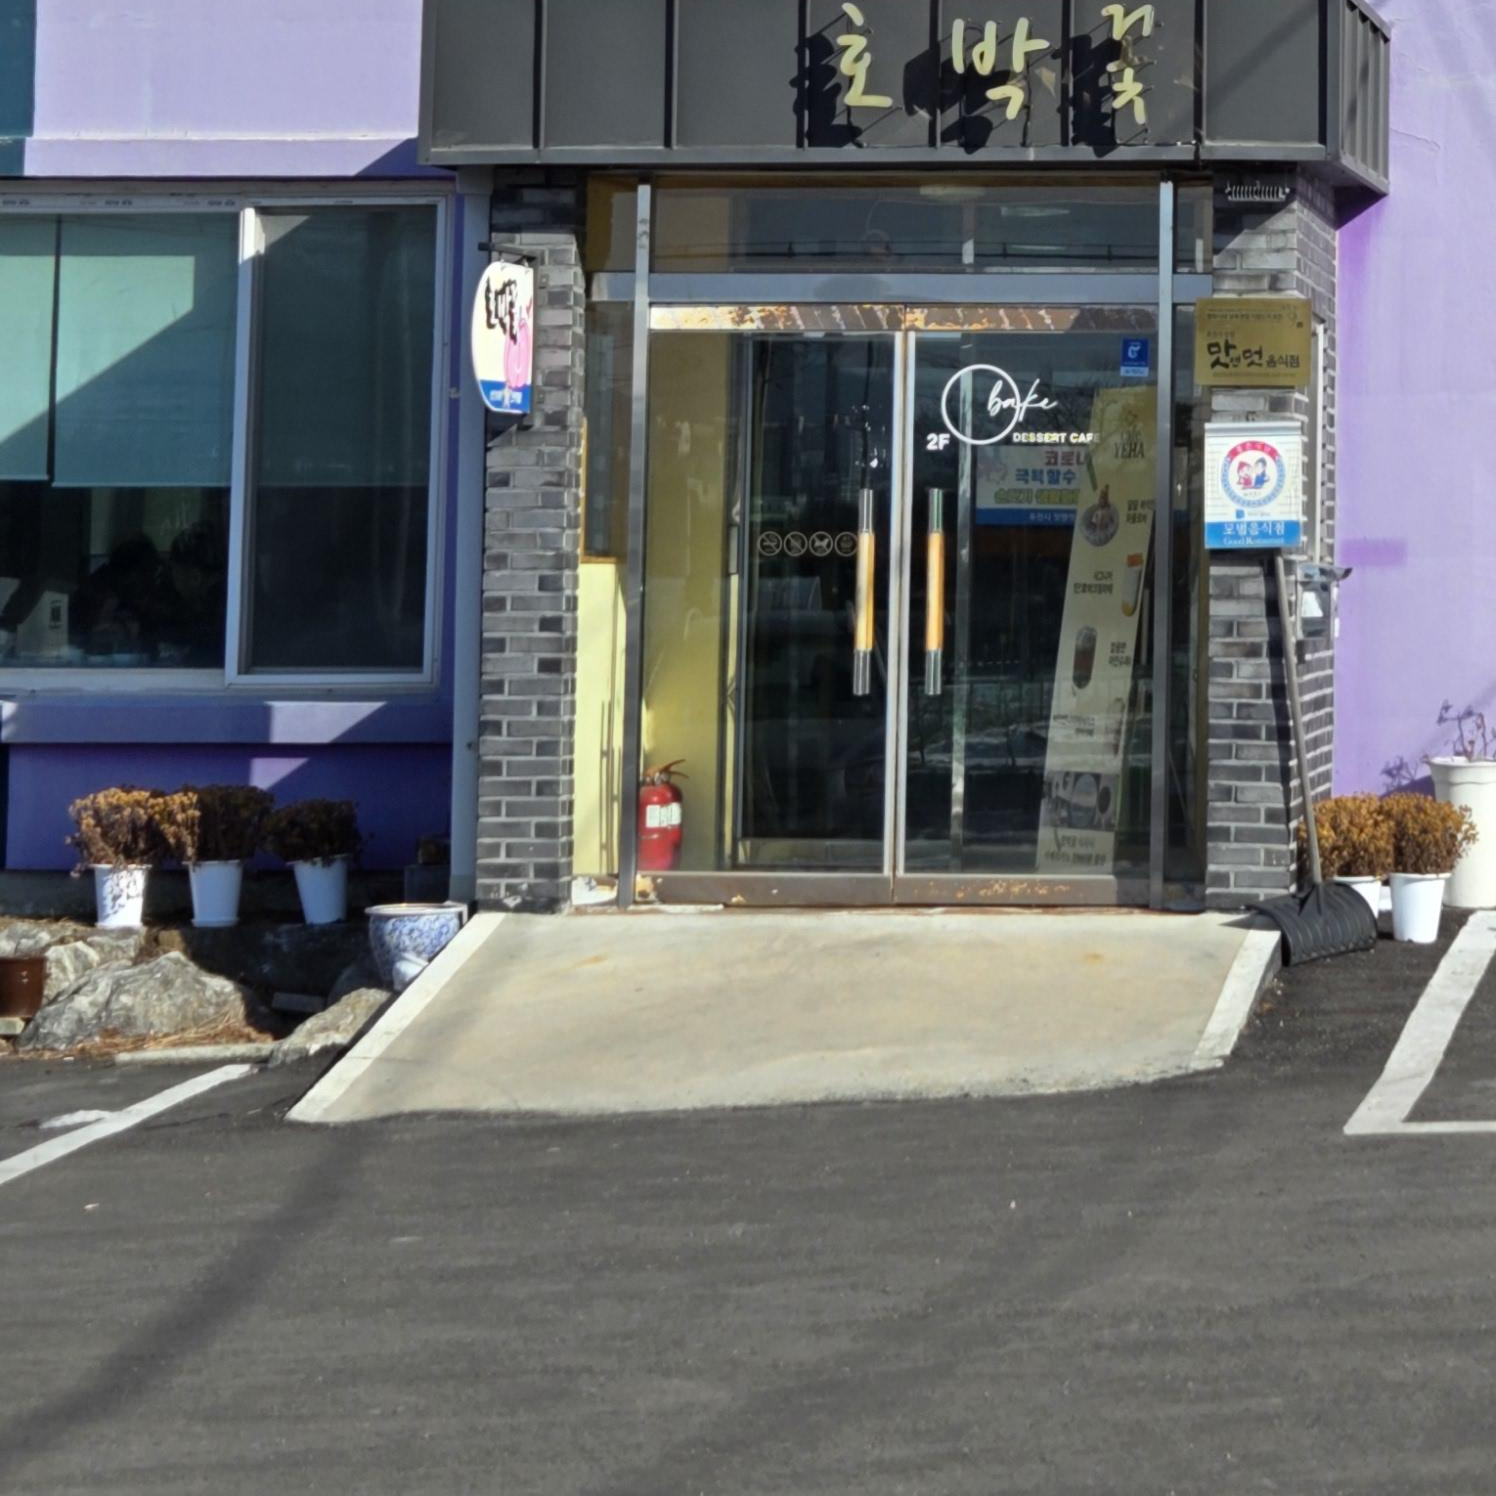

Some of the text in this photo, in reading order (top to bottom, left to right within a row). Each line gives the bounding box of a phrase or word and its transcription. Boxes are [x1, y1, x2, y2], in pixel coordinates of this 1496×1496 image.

[987, 378, 1058, 423] bake
[926, 432, 950, 450] 2F
[1012, 432, 1100, 444] DESSERT CAFE
[1223, 520, 1285, 536] 모범음식점
